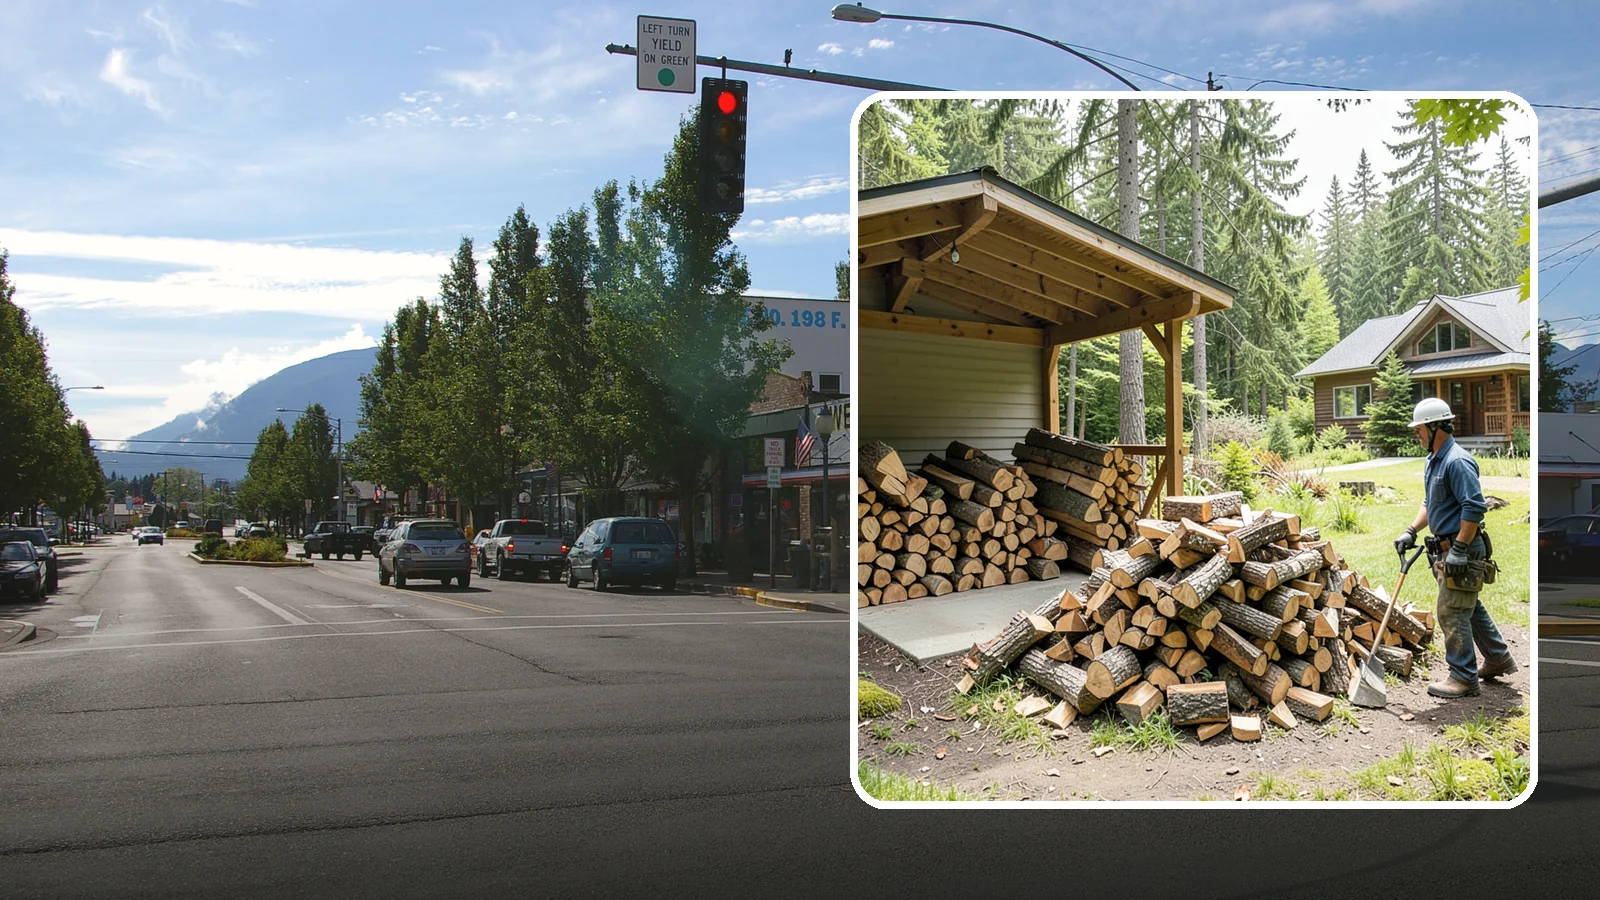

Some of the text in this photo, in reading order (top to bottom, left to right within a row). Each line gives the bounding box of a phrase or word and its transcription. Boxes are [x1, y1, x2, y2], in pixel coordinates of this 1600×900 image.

[643, 24, 690, 36] LEFT TURN
[652, 38, 682, 51] YIELD
[644, 53, 688, 66] ON GREEN
[791, 309, 826, 327] 198
[831, 311, 846, 329] F.
